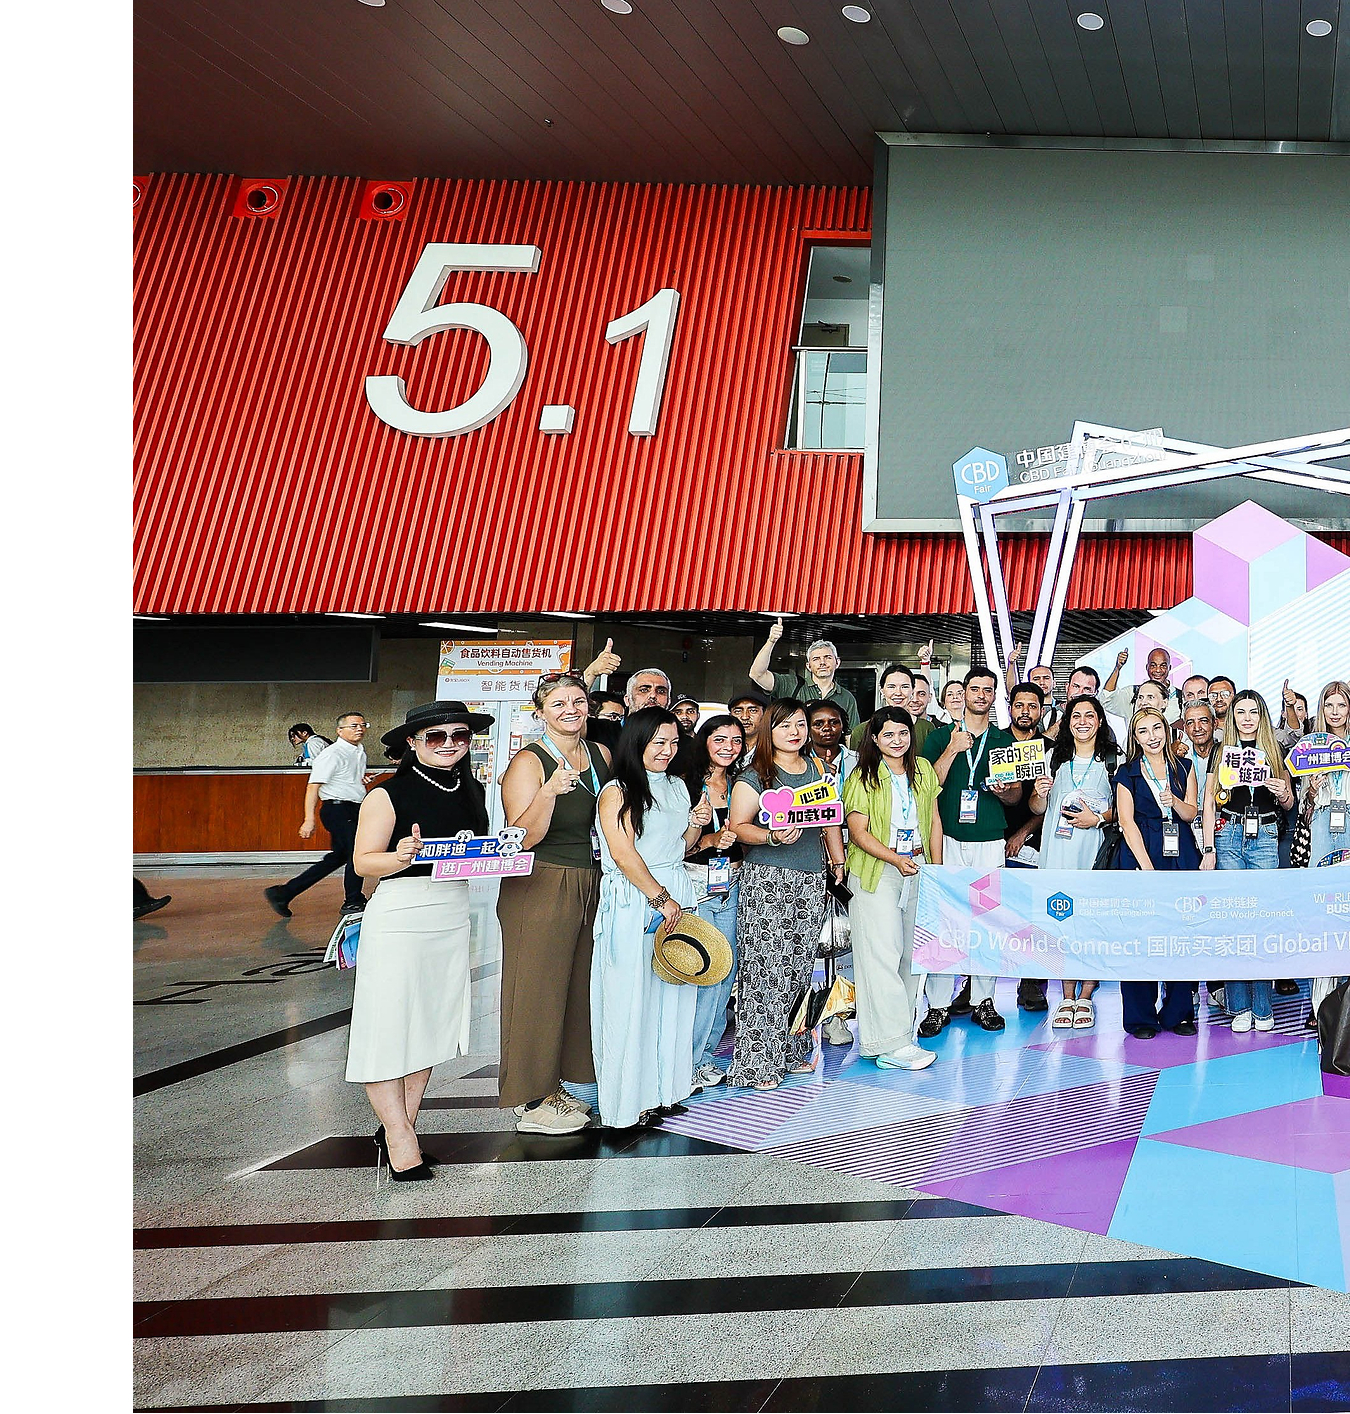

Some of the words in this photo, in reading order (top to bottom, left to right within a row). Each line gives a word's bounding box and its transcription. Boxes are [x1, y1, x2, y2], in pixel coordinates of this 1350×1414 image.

[365, 242, 681, 438] 5.1
[961, 460, 999, 485] CBD
[1019, 467, 1050, 484] CBD
[974, 484, 992, 495] Fair
[460, 647, 552, 659] 食品饮料自动售货机
[477, 660, 504, 668] Vending
[505, 659, 533, 667] Machine
[481, 680, 537, 692] 智能货柜
[991, 748, 1022, 765] 家的
[1225, 750, 1256, 768] 指尖
[1015, 762, 1046, 779] 瞬间
[1238, 767, 1268, 783] 链动
[800, 786, 829, 804] 心动
[787, 807, 836, 824] 加载中
[419, 841, 496, 858] 和胖迪一起
[440, 858, 529, 876] 逛广州建博会
[1050, 899, 1070, 911] CBD
[1175, 896, 1203, 913] CBD
[1210, 896, 1259, 909] 全球链接
[1209, 911, 1228, 919] CBD
[1230, 909, 1294, 919] World-Connect
[938, 928, 981, 950] CBD
[988, 930, 1141, 957] World-Connect
[1147, 933, 1258, 958] 国际买家团
[1263, 932, 1328, 954] Global
